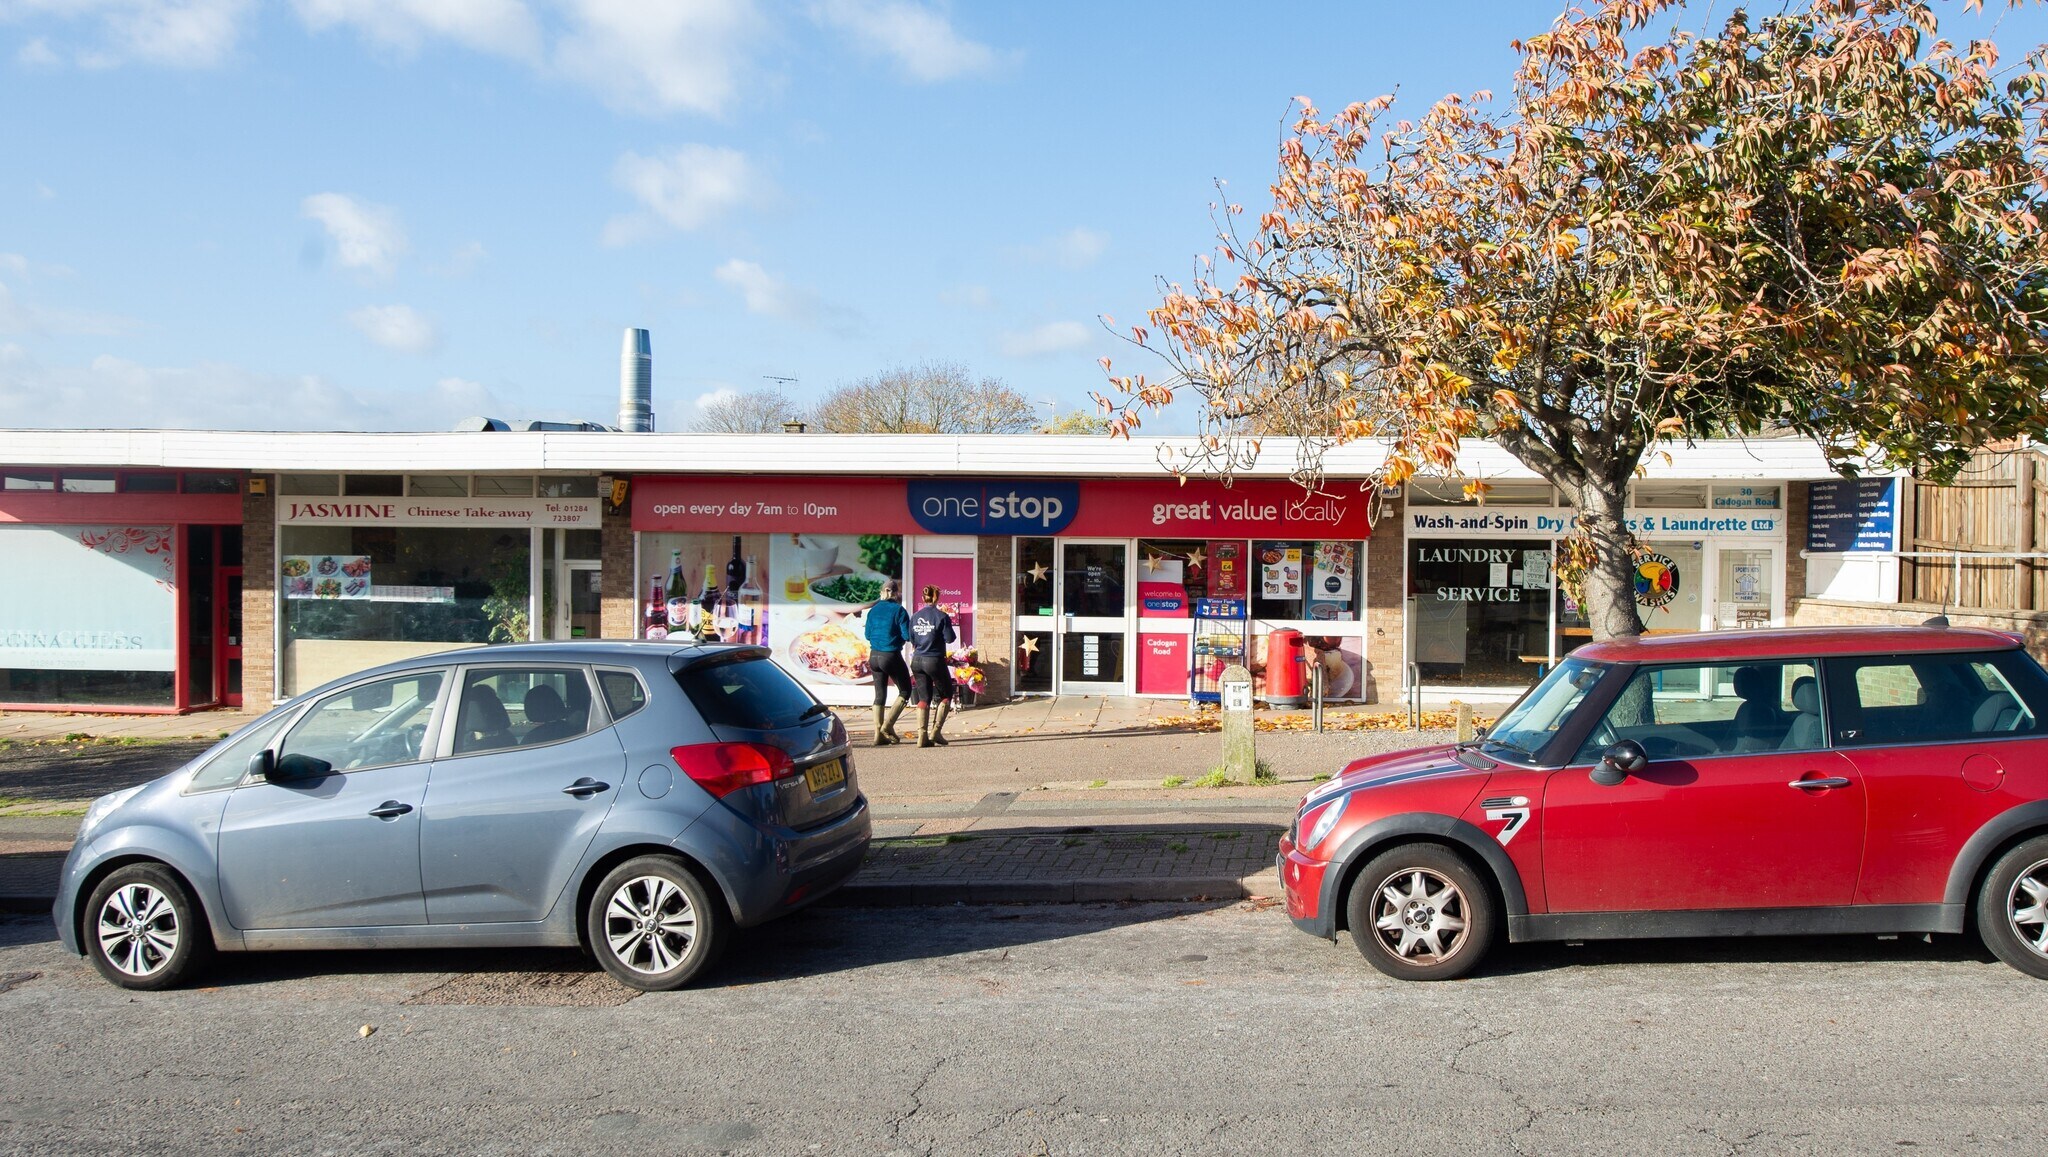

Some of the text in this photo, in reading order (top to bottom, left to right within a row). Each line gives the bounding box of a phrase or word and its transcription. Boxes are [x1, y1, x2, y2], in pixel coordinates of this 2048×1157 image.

[1380, 488, 1399, 496] wift
[1740, 488, 1752, 496] 30
[653, 502, 838, 518] open every day 7am to 10pm
[922, 490, 1063, 528] one stop
[1714, 498, 1777, 507] Cadogan Road
[288, 503, 534, 521] JASMINE Chinese Take-away
[1152, 499, 1347, 526] great value locally
[1414, 514, 1529, 532] Wash-and-Spin
[1537, 516, 1564, 532] Dry
[1642, 516, 1656, 531] &
[1662, 516, 1748, 531] Laundrette
[1754, 520, 1773, 530] Ltd.
[1418, 548, 1518, 563] LAUNDRY
[1632, 554, 1675, 570] SERVICE
[1144, 590, 1172, 598] welcome
[1436, 586, 1521, 602] SERVICE
[1634, 590, 1676, 607] WASHES
[1162, 600, 1179, 610] stop
[0, 632, 60, 648] GINA
[1147, 639, 1178, 648] Cadogan
[1152, 648, 1171, 656] Road
